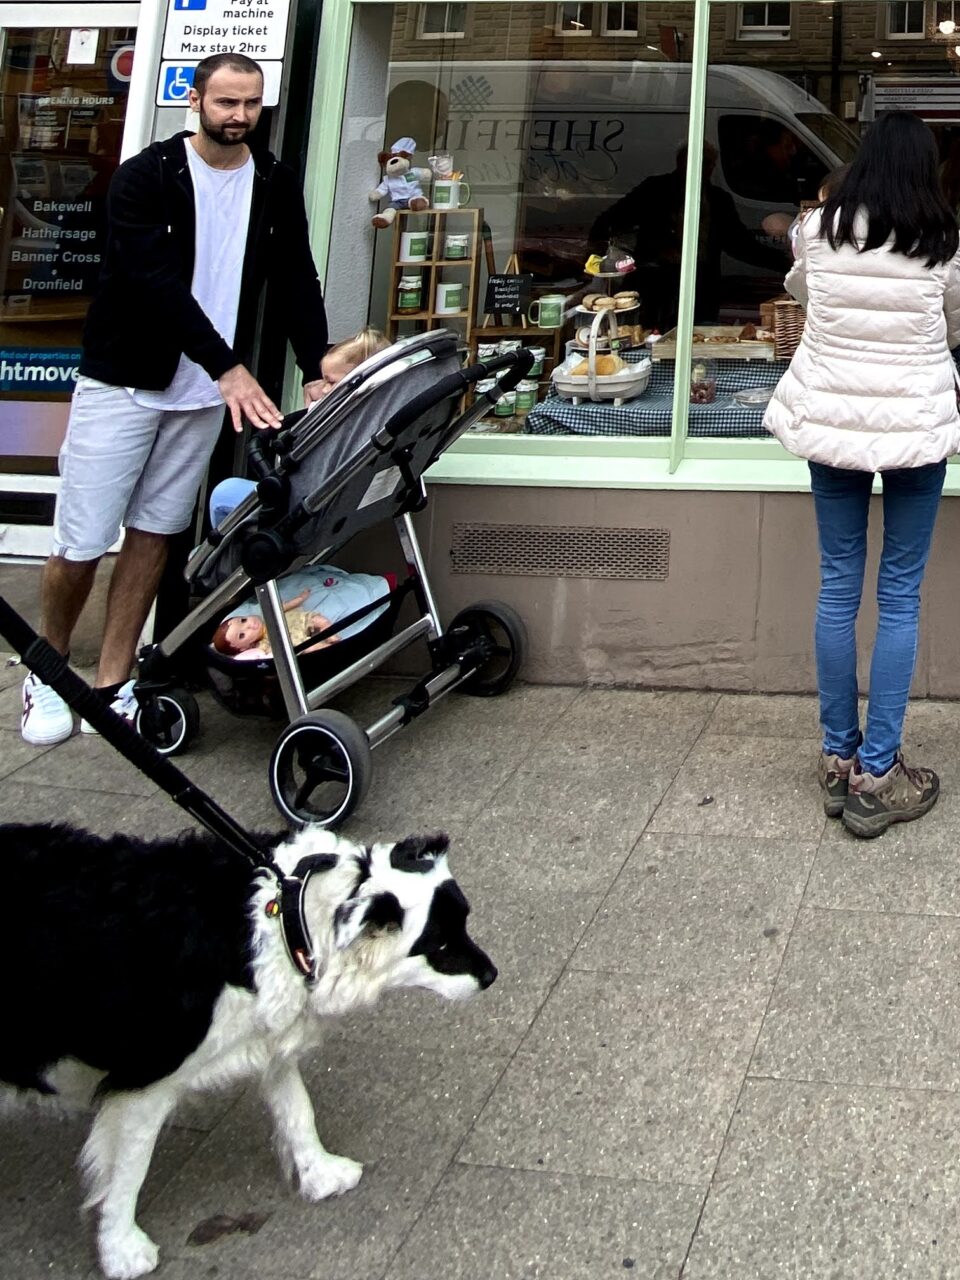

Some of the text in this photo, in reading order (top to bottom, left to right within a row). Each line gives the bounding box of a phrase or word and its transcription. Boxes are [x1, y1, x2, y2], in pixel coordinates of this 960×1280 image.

[223, 8, 274, 18] machine
[184, 25, 268, 37] Display ticket
[181, 42, 267, 53] Max stay 2hrs
[81, 96, 114, 105] HOURS
[33, 200, 92, 212] Bakewell
[22, 227, 97, 241] Hathersage
[11, 250, 101, 263] Banner Cross
[22, 278, 83, 290] Dronfield
